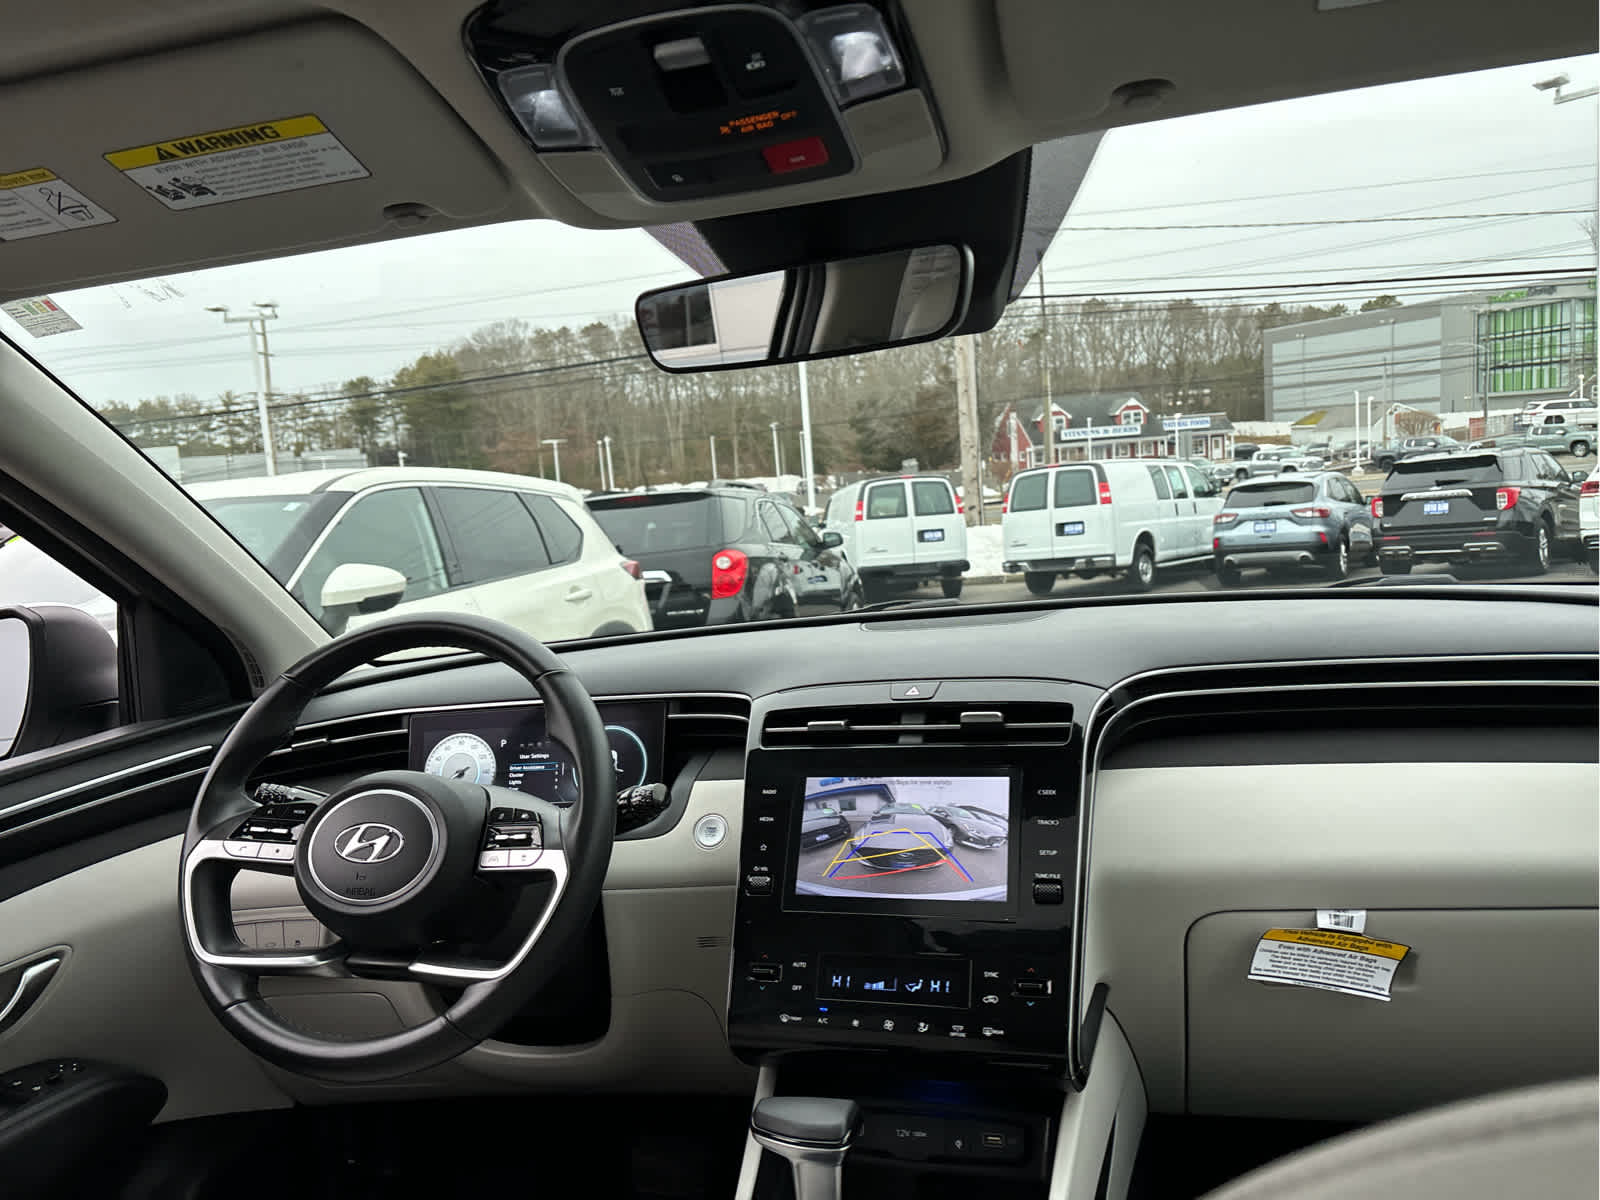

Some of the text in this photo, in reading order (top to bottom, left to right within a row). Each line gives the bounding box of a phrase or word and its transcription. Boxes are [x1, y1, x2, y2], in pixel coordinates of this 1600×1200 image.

[729, 110, 797, 126] PASSENGER OFF
[741, 121, 774, 132] AIR BAG
[173, 125, 281, 155] WARNING
[500, 739, 508, 748] P
[530, 752, 550, 760] Settings
[1312, 948, 1347, 957] Advanced
[832, 975, 851, 989] HI
[929, 979, 950, 993] HI
[896, 1128, 911, 1138] 12V
